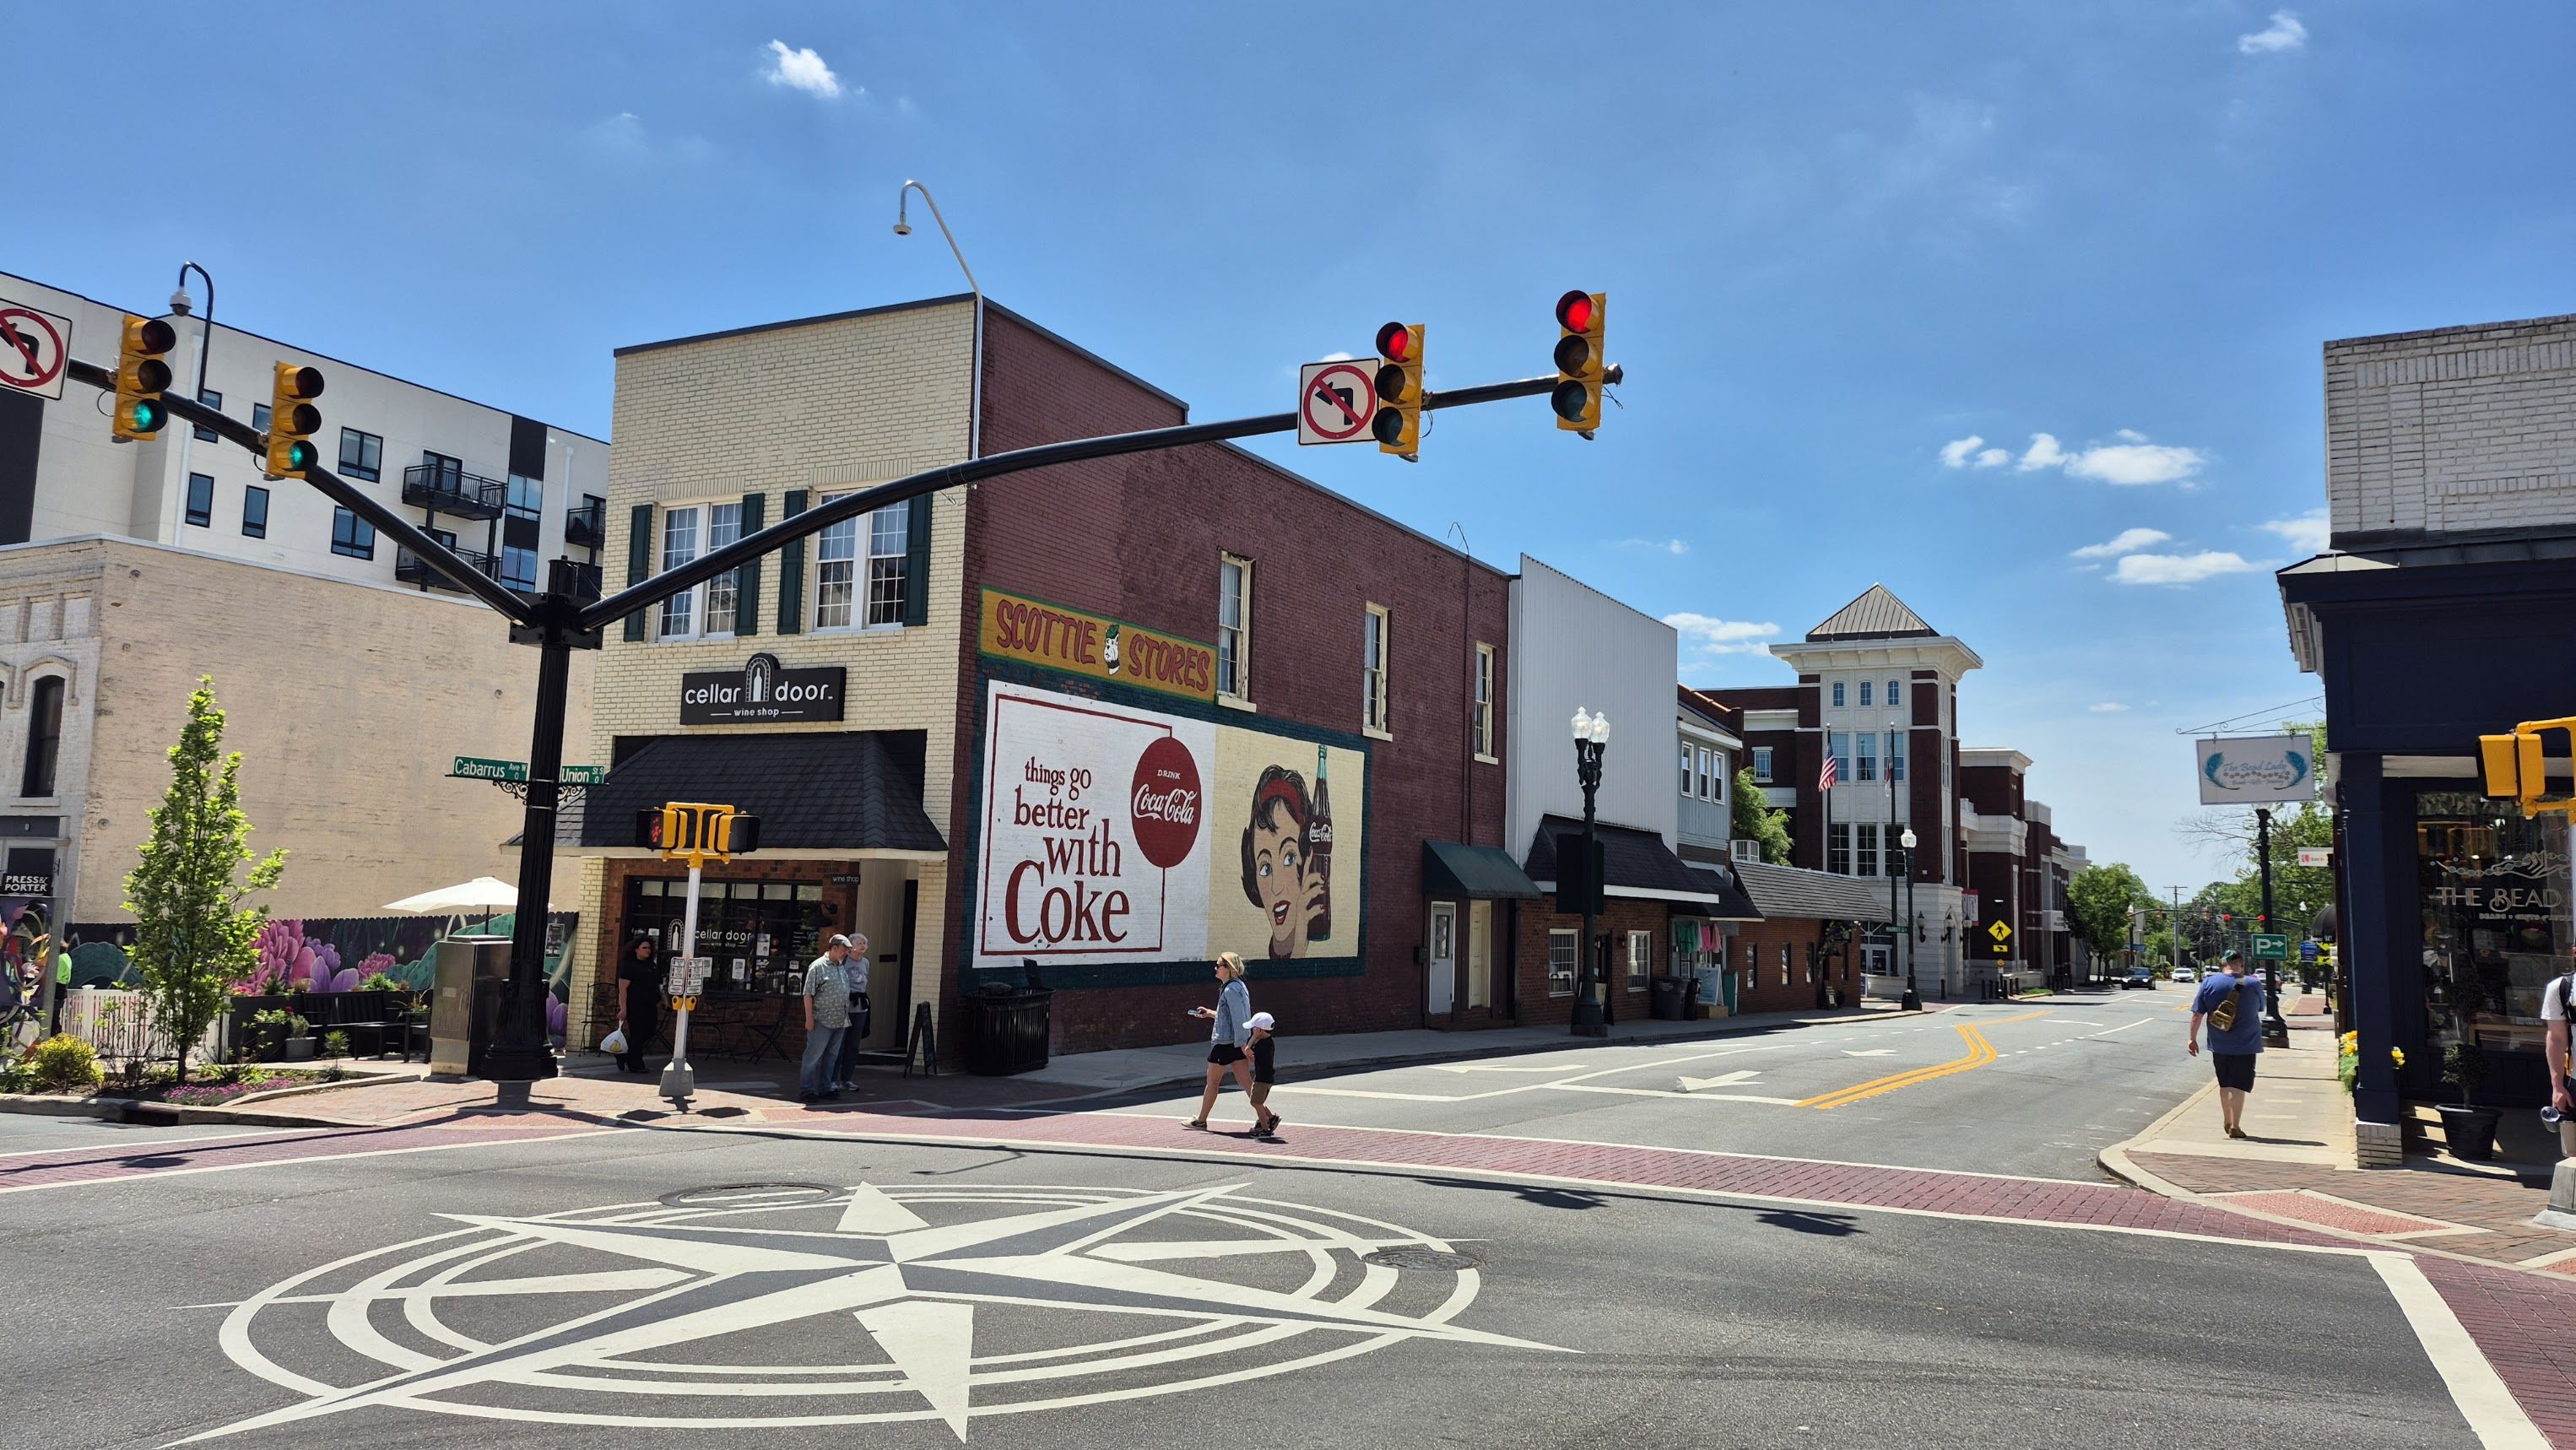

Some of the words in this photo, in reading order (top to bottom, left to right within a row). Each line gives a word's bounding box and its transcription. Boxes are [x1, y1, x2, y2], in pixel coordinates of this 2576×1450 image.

[996, 599, 1097, 664] SCOTTIE
[1128, 633, 1210, 692] STORES
[685, 684, 741, 704] cellar
[775, 681, 830, 701] door
[757, 707, 780, 718] shop
[455, 760, 506, 777] Cabarrus
[508, 763, 521, 771] Ave
[521, 764, 528, 772] W
[561, 768, 590, 783] Union
[1157, 769, 1181, 780] DRINK
[2223, 762, 2238, 772] The
[1025, 756, 1065, 796] things
[1069, 767, 1092, 801] go
[1014, 784, 1090, 831] better
[1133, 783, 1198, 825] Coca-Cola
[1042, 819, 1121, 877] with
[4, 884, 47, 892] PORTER
[1004, 859, 1130, 944] Coke
[2429, 887, 2483, 906] THE
[2489, 888, 2562, 912] BEAD
[695, 928, 722, 939] cellar
